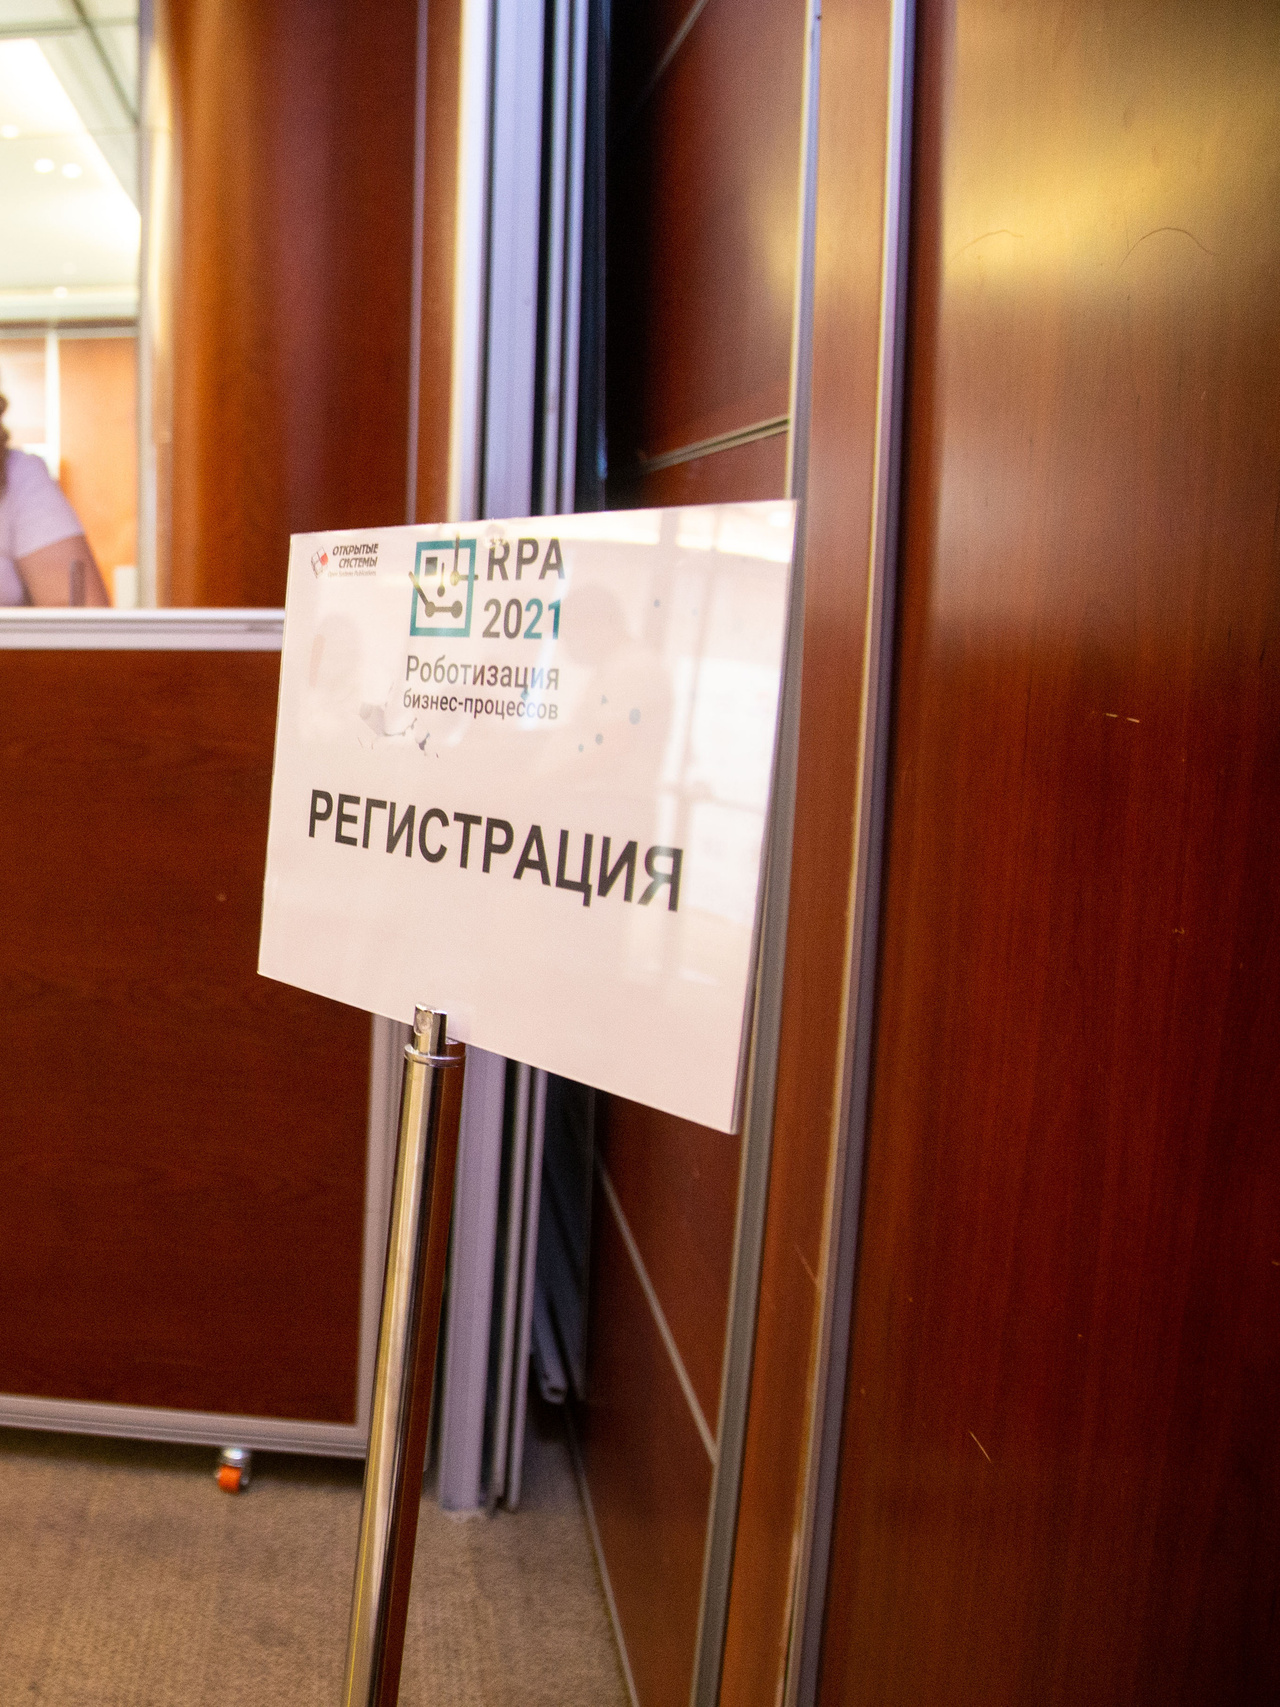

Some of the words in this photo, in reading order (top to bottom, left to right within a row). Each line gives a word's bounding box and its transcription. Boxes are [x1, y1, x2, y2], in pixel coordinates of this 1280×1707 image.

[332, 543, 379, 556] ОТКРЫТЫЕ
[338, 556, 378, 569] СИСТЕМЫ
[486, 537, 565, 581] RPA
[481, 597, 562, 640] 2021
[405, 654, 560, 694] Роботизация
[402, 688, 559, 721] бизнес-процессов
[308, 788, 684, 913] РЕГИСТРАЦИЯ
